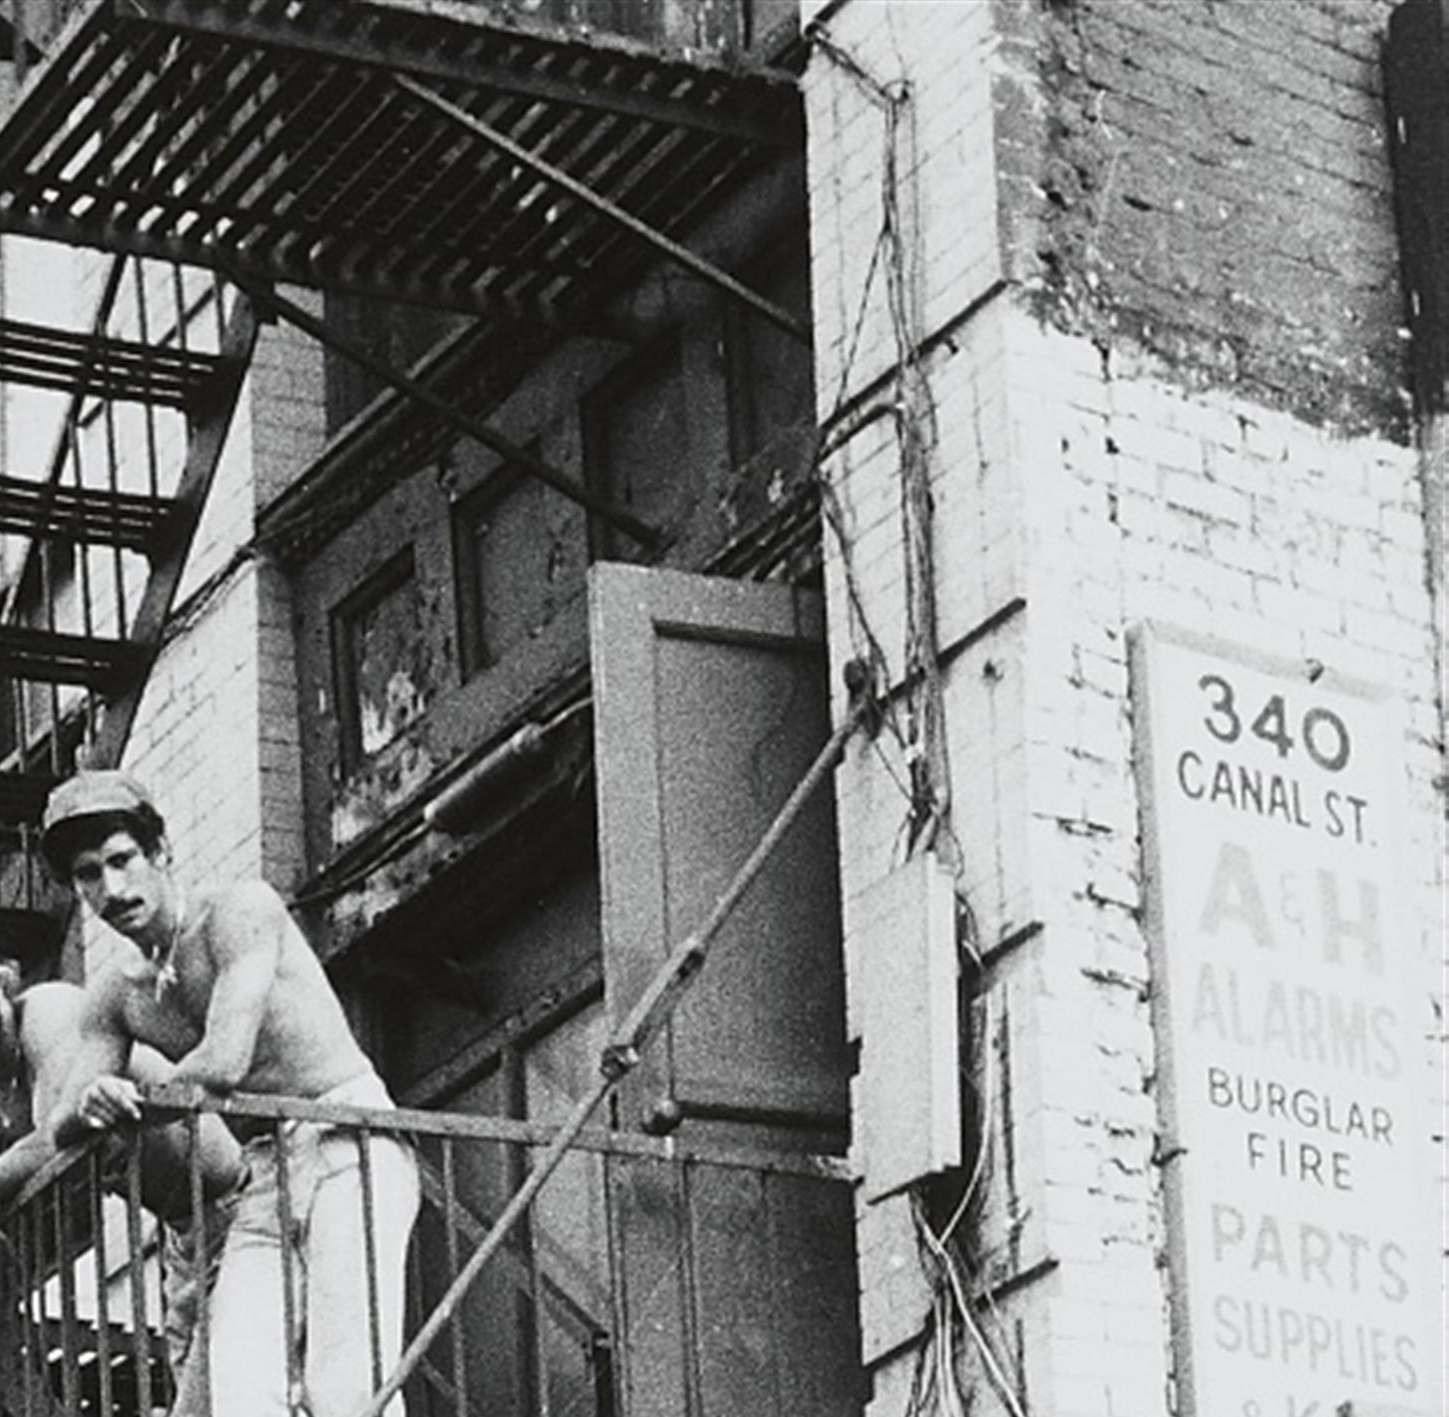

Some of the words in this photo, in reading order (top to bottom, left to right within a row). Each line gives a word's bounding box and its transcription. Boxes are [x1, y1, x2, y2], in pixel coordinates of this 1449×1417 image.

[1198, 674, 1351, 772] 340
[1178, 752, 1311, 829] CANAL
[1190, 962, 1404, 1082] ALARMS
[1207, 1066, 1393, 1146] BURGLAR
[1248, 1131, 1355, 1193] FIRE
[1211, 1203, 1409, 1303] PARTS
[1214, 1294, 1418, 1392] SUPPLIES
